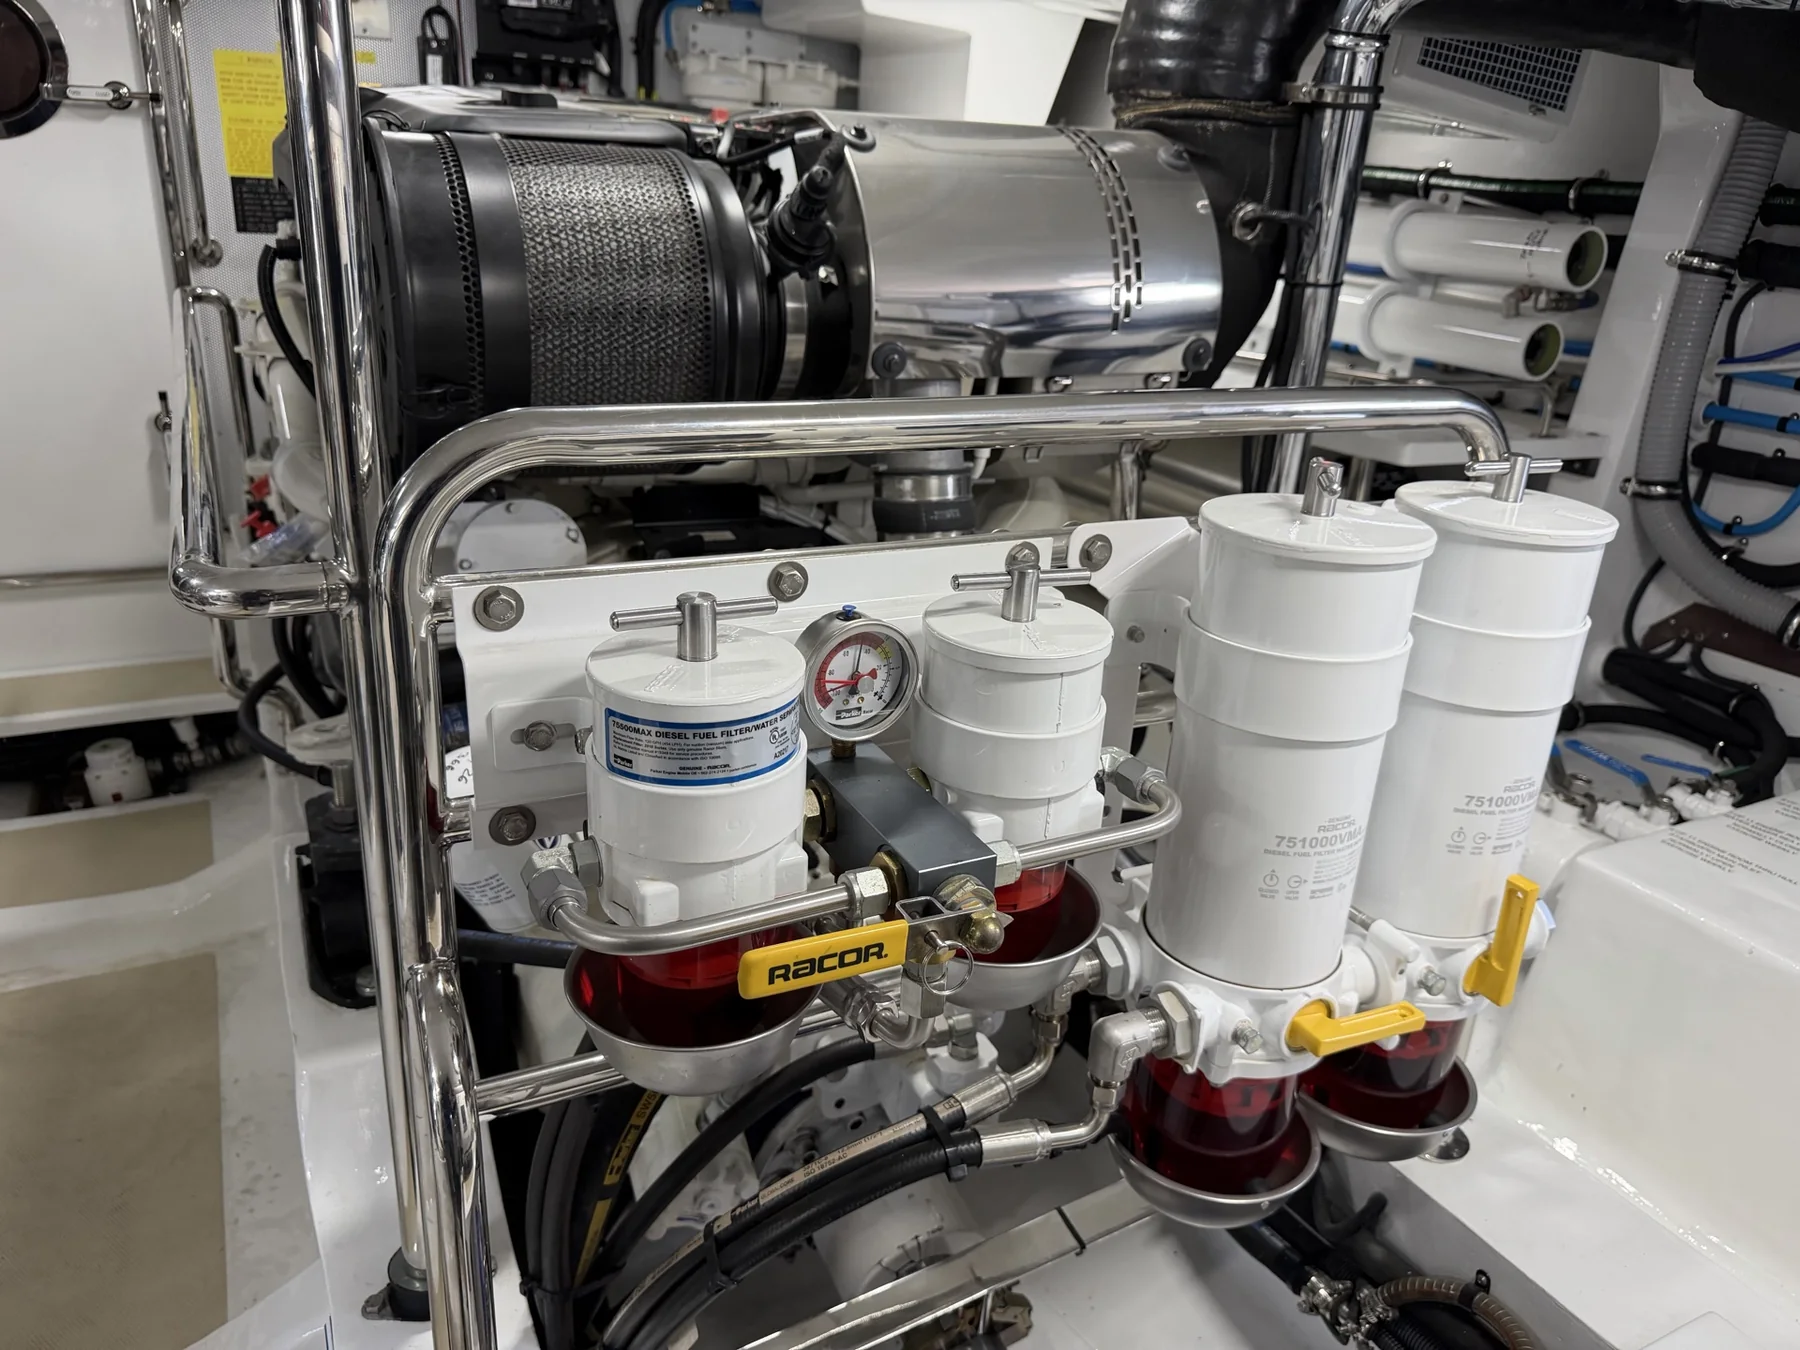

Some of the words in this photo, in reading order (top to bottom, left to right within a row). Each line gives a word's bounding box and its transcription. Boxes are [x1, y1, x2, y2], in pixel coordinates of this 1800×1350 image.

[612, 720, 653, 737] 75500MAX
[655, 730, 690, 740] DIESEL
[692, 731, 718, 740] FUEL
[721, 718, 778, 738] FILTER/WATER
[803, 1166, 816, 1178] ISO
